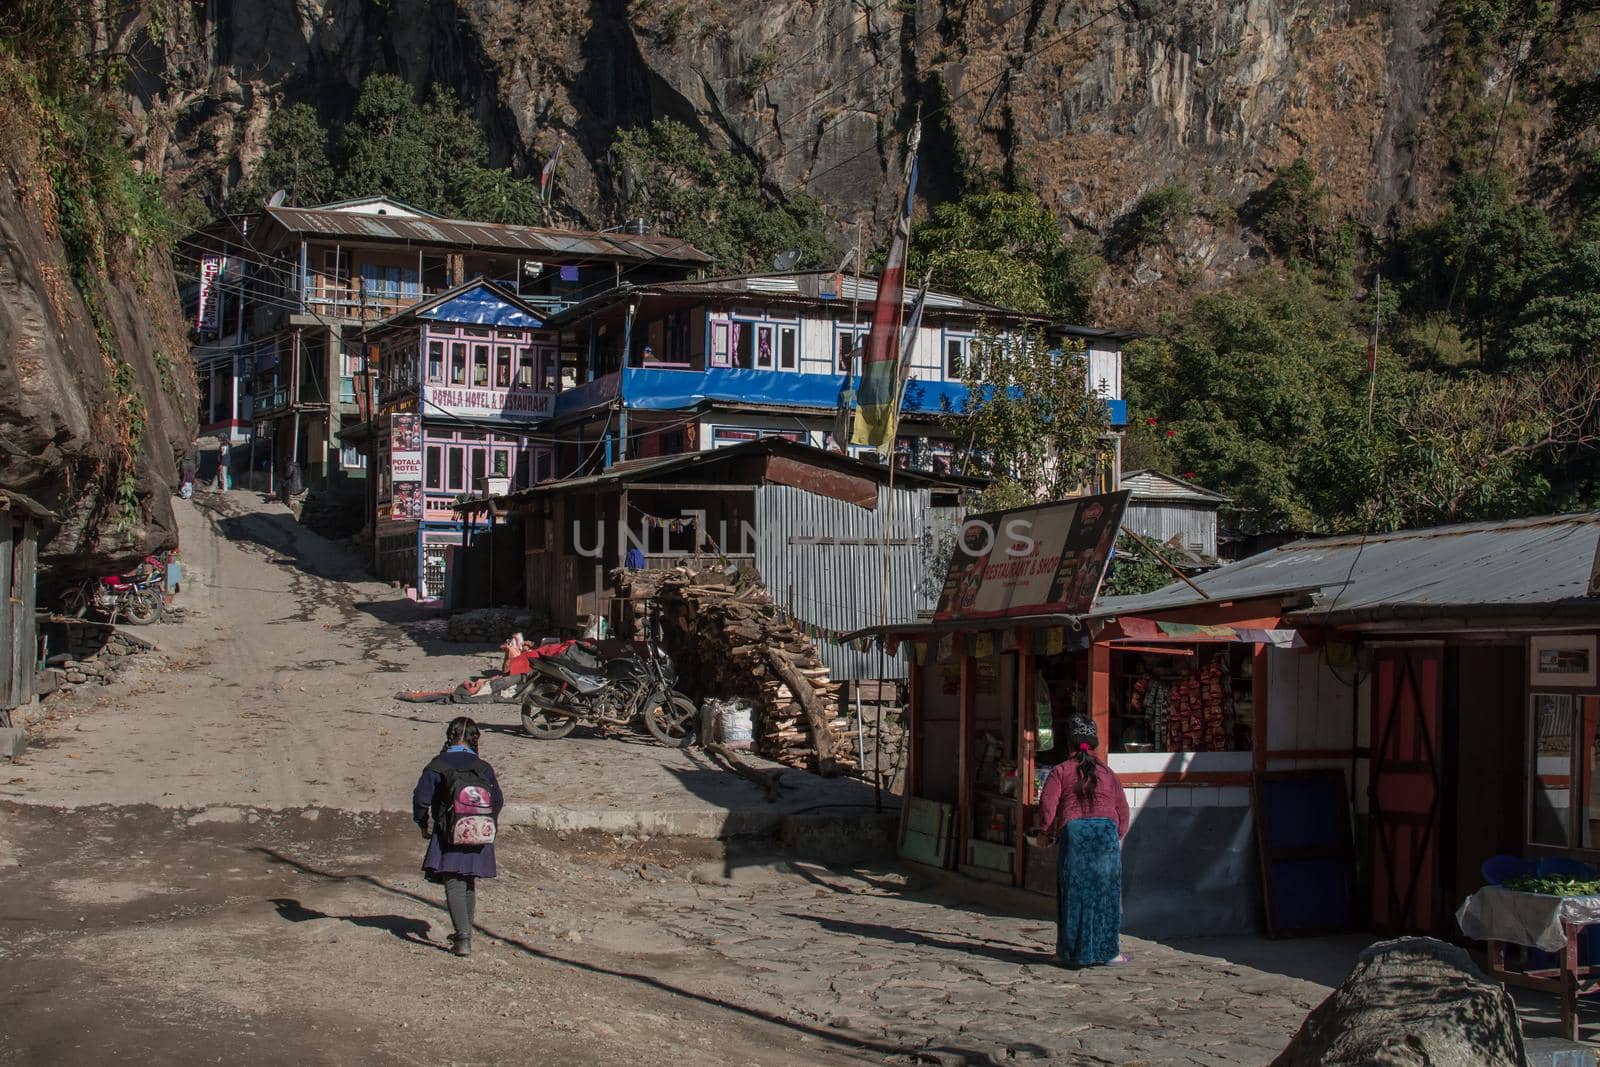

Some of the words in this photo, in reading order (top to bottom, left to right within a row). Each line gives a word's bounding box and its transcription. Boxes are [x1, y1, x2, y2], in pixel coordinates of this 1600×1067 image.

[432, 390, 463, 407] POTALA
[465, 391, 489, 408] HOTEL
[492, 394, 497, 409] &
[499, 394, 549, 412] RESTAURANT
[1037, 555, 1060, 576] SHOP
